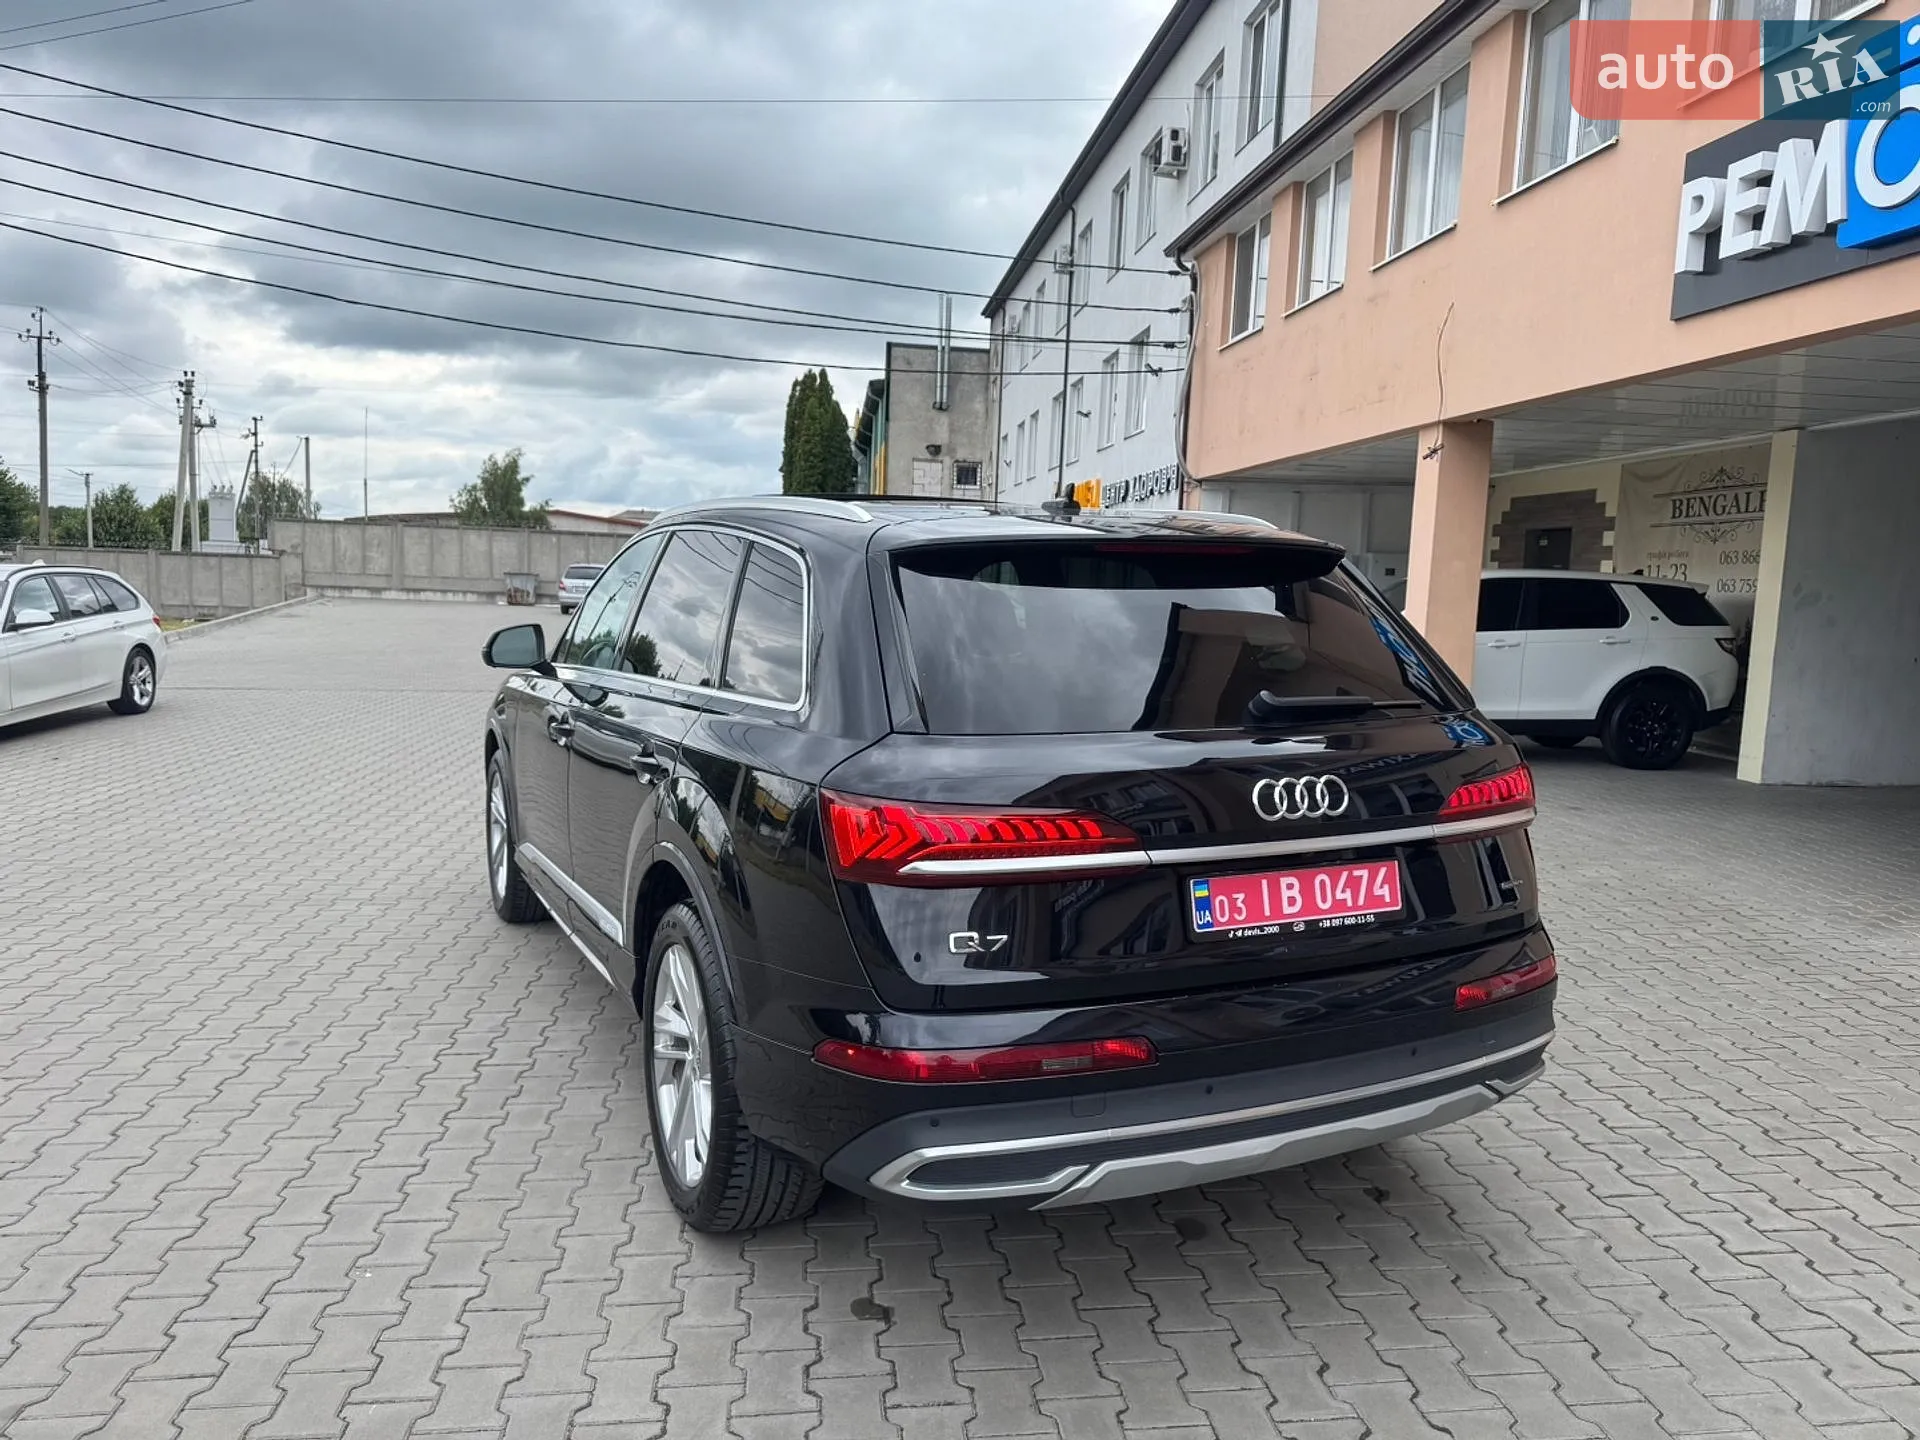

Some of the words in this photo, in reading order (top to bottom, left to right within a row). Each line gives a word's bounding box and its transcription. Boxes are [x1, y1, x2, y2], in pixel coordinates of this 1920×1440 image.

[1214, 892, 1247, 923] 03
[1314, 866, 1391, 911] 0474
[1196, 910, 1213, 925] UA
[949, 931, 1009, 953] Q7
